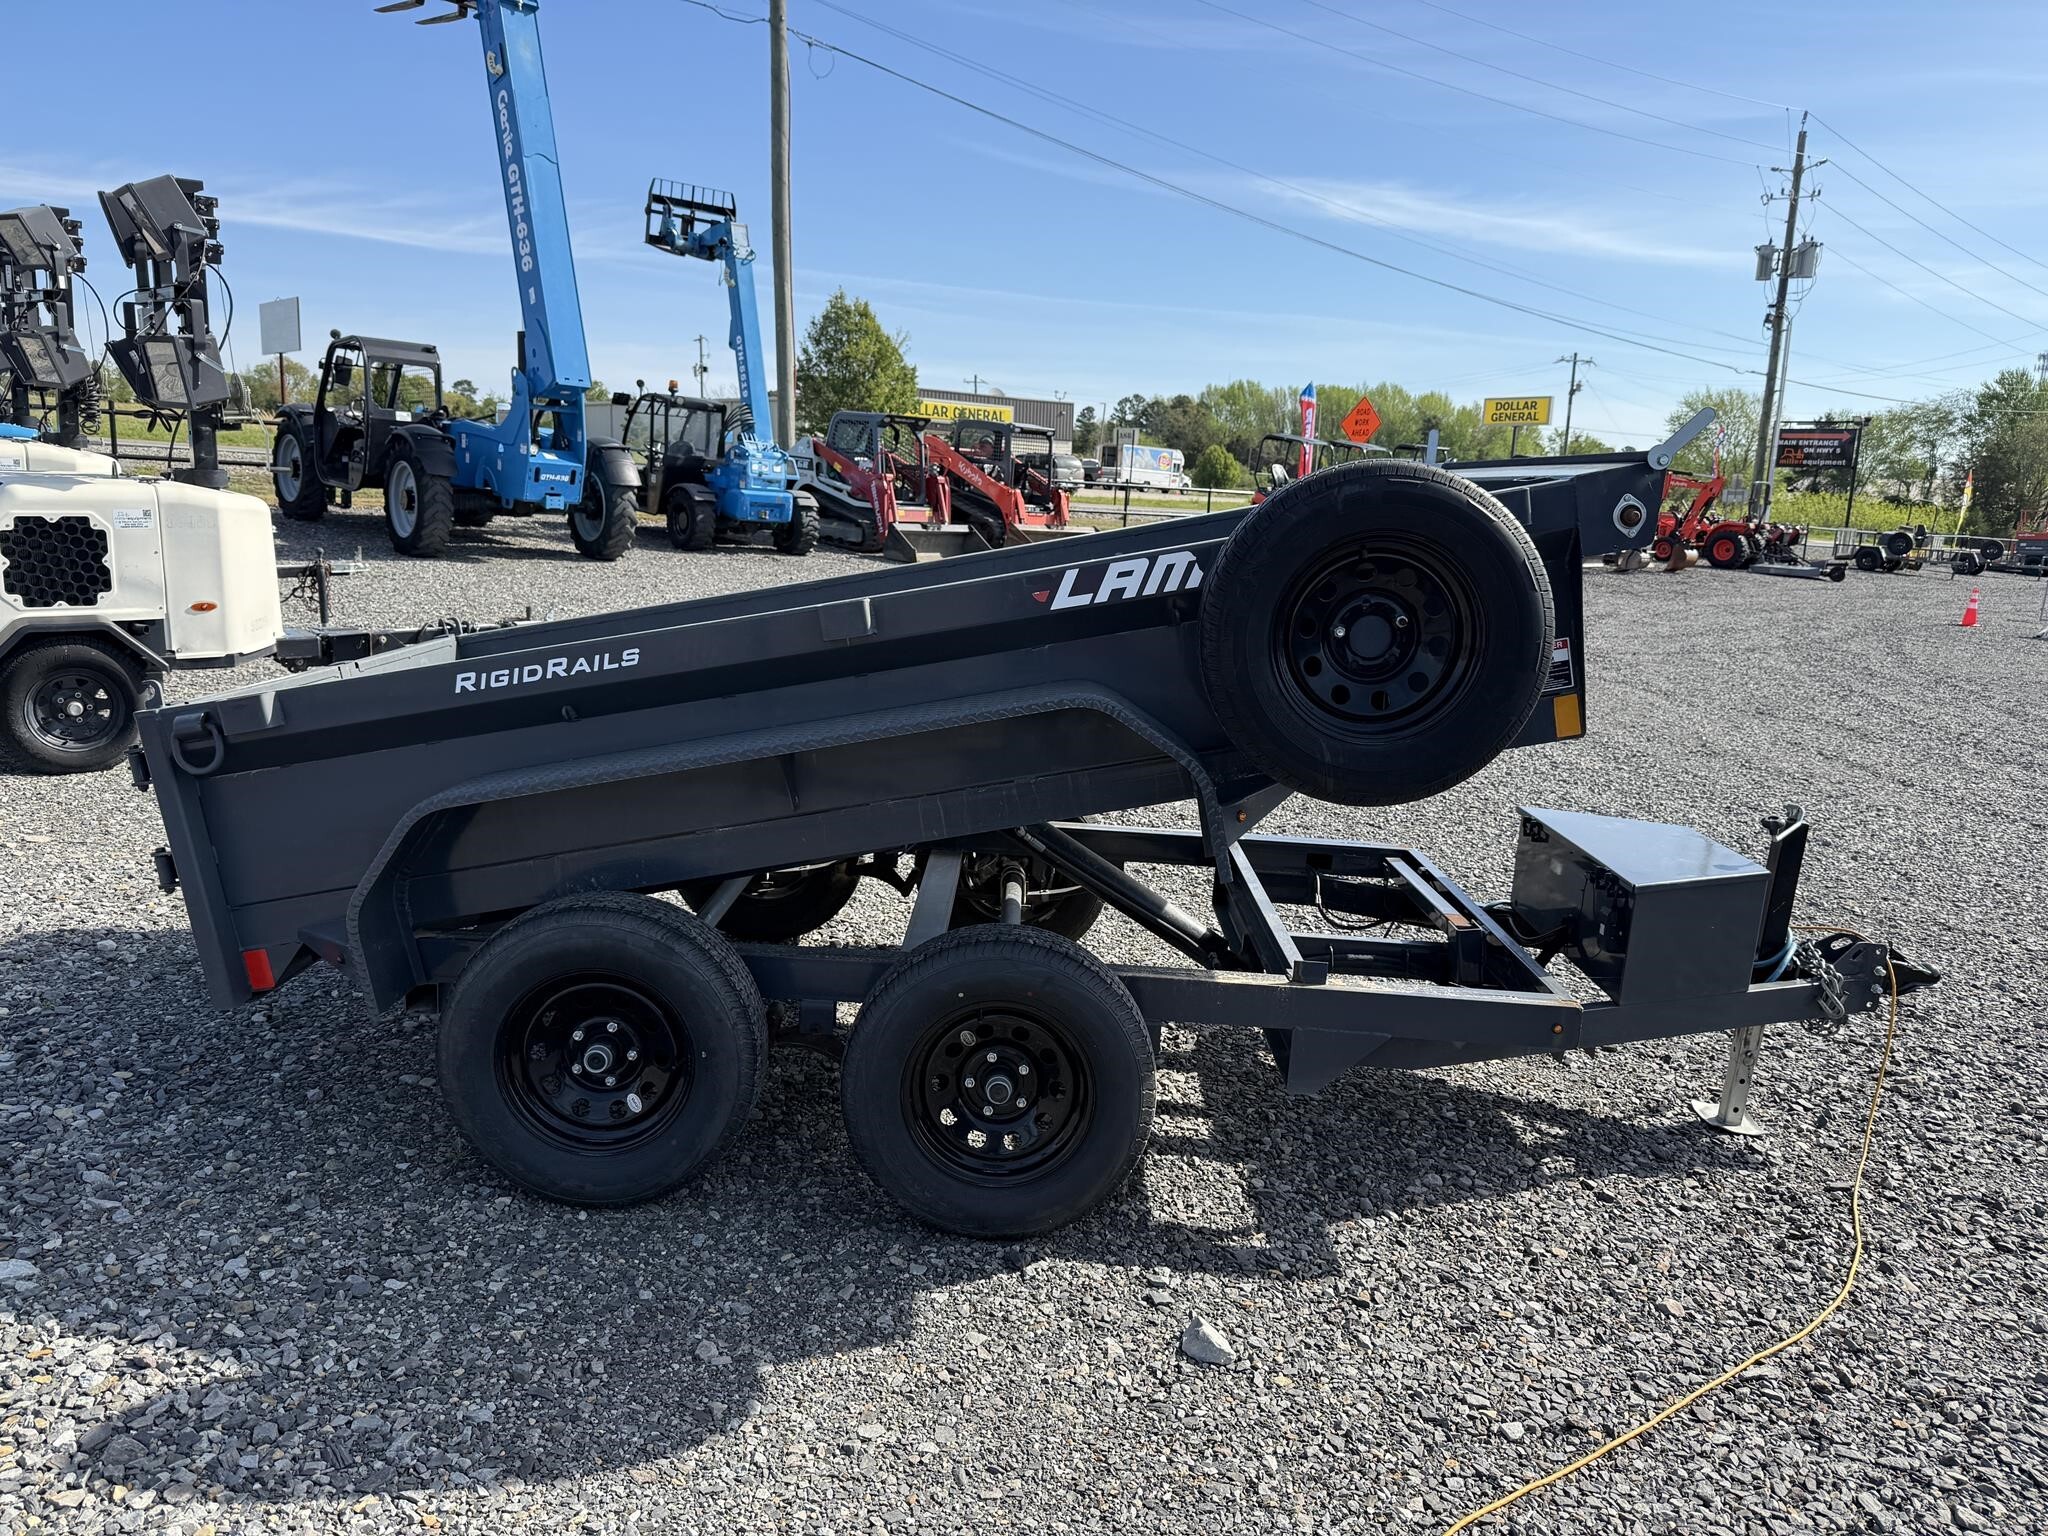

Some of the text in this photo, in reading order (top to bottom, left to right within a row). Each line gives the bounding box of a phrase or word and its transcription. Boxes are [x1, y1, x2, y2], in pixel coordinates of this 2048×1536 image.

[497, 89, 533, 273] Genie GTH-636
[1495, 401, 1538, 411] DOLLAR
[953, 406, 1005, 422] GENERAL
[1356, 408, 1371, 416] ROAD
[1491, 411, 1539, 422] GENERAL
[1354, 418, 1369, 426] WORK
[1351, 429, 1370, 437] AHEAD
[1050, 551, 1204, 611] LAM
